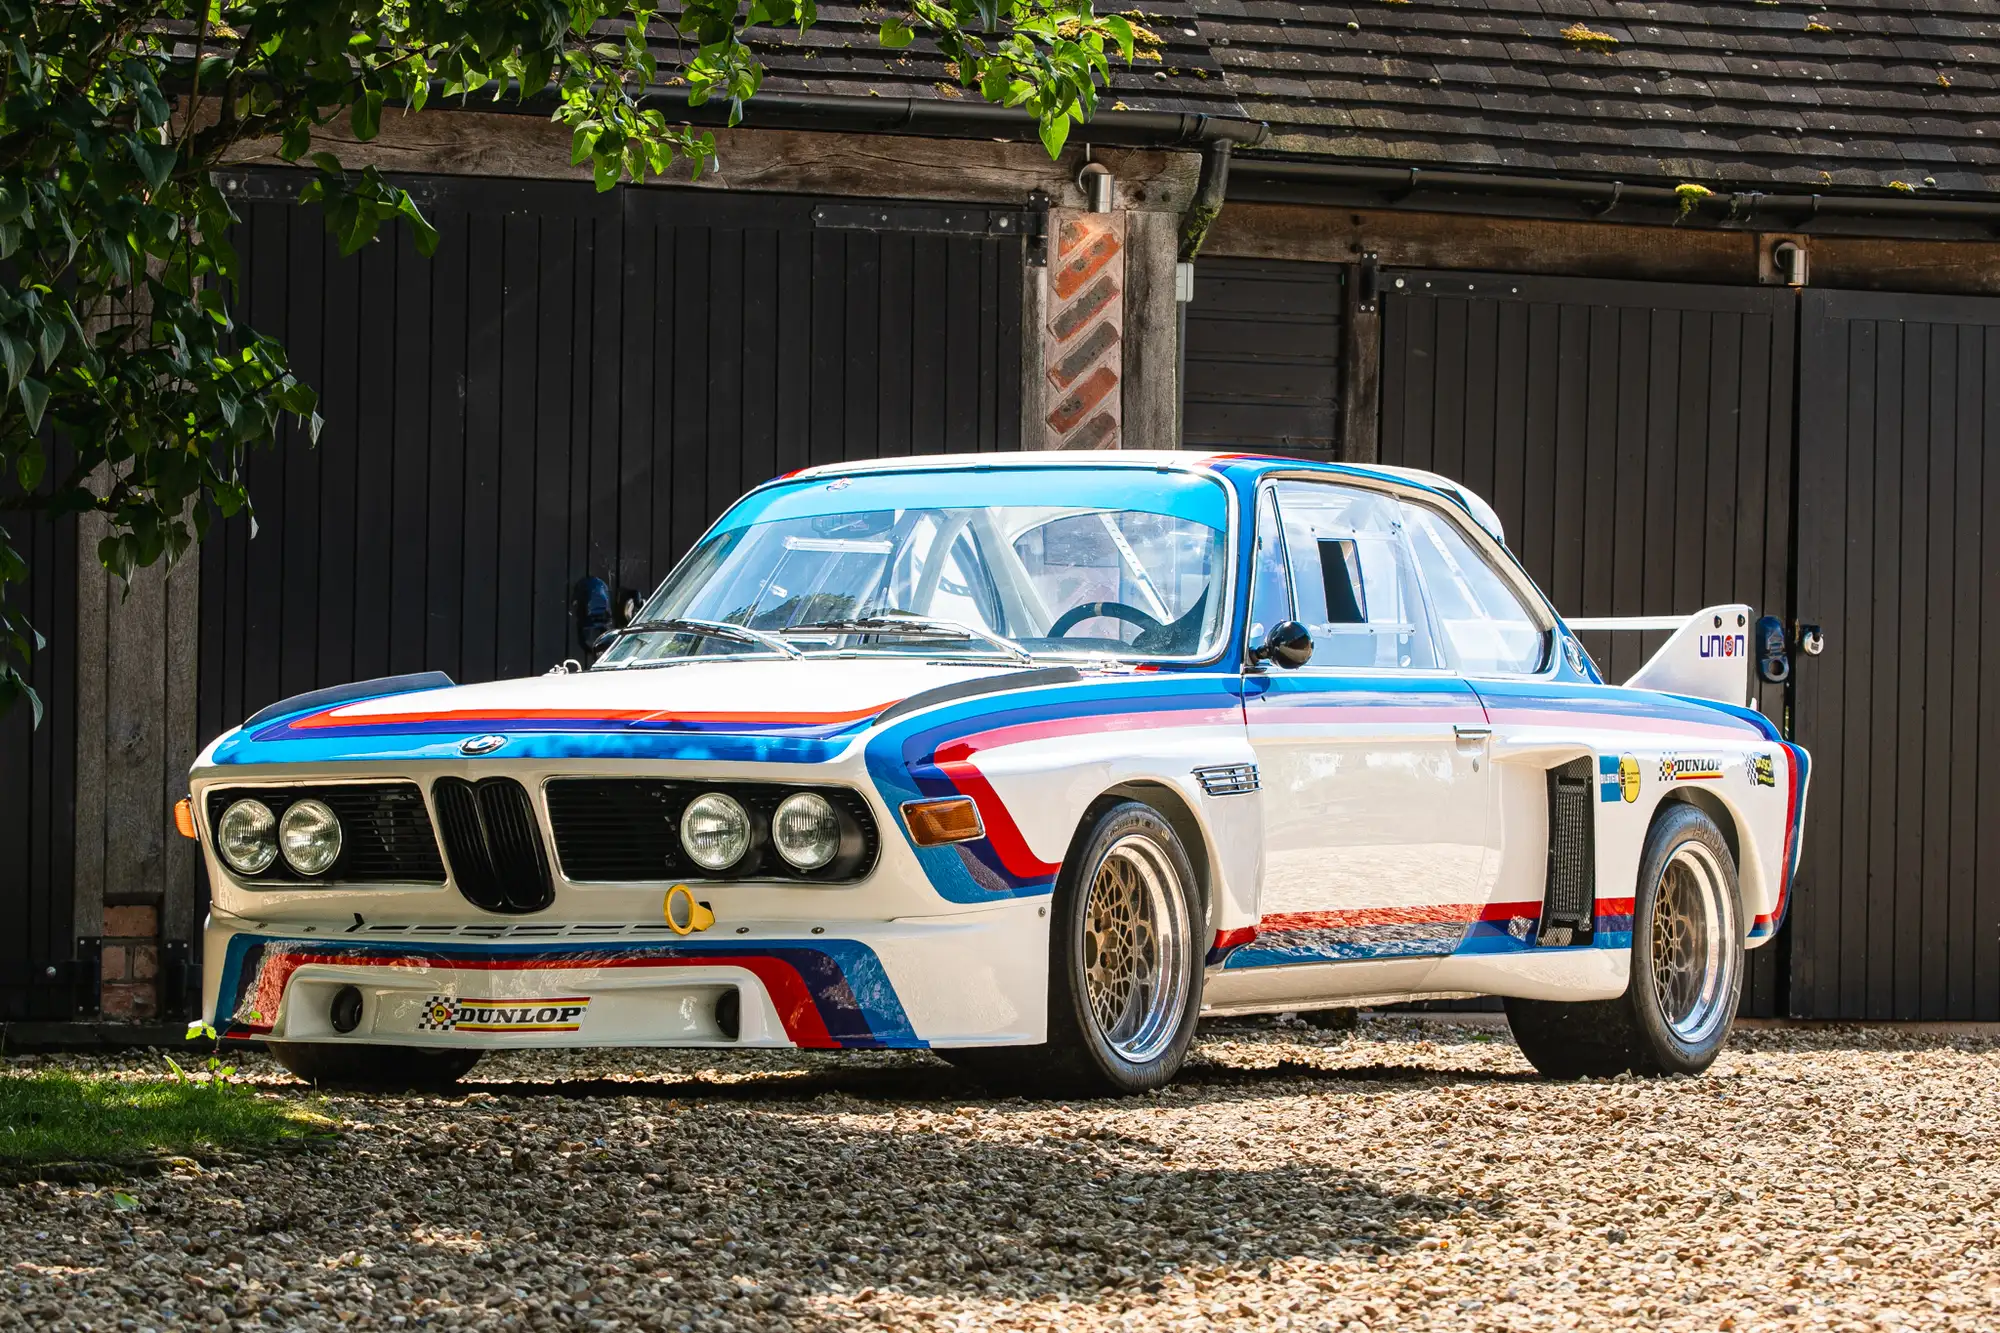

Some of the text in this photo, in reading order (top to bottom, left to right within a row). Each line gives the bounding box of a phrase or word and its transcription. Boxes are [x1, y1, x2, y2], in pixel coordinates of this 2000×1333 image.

[1676, 759, 1722, 771] DUNLOP
[435, 1009, 444, 1017] D
[458, 1007, 582, 1024] DUNLOP
